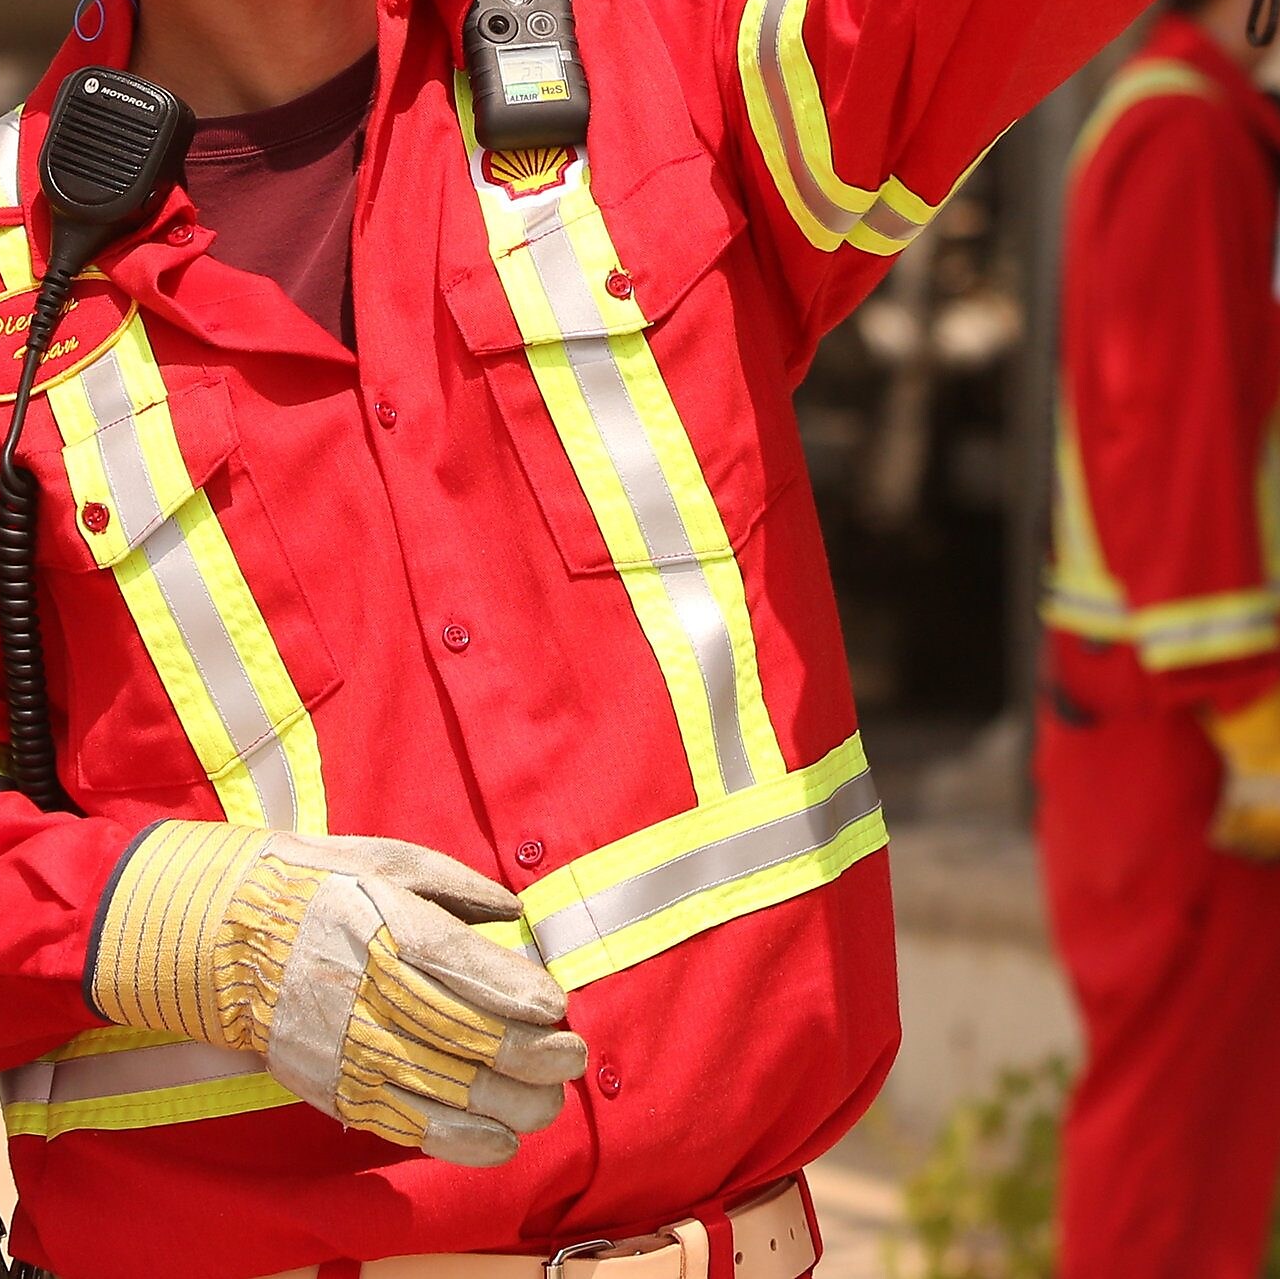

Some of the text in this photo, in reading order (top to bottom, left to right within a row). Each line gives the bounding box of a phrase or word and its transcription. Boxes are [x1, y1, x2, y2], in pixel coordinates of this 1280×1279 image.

[541, 85, 563, 95] H2S
[101, 86, 155, 112] MOTOROLA
[510, 93, 538, 102] ALTAIR
